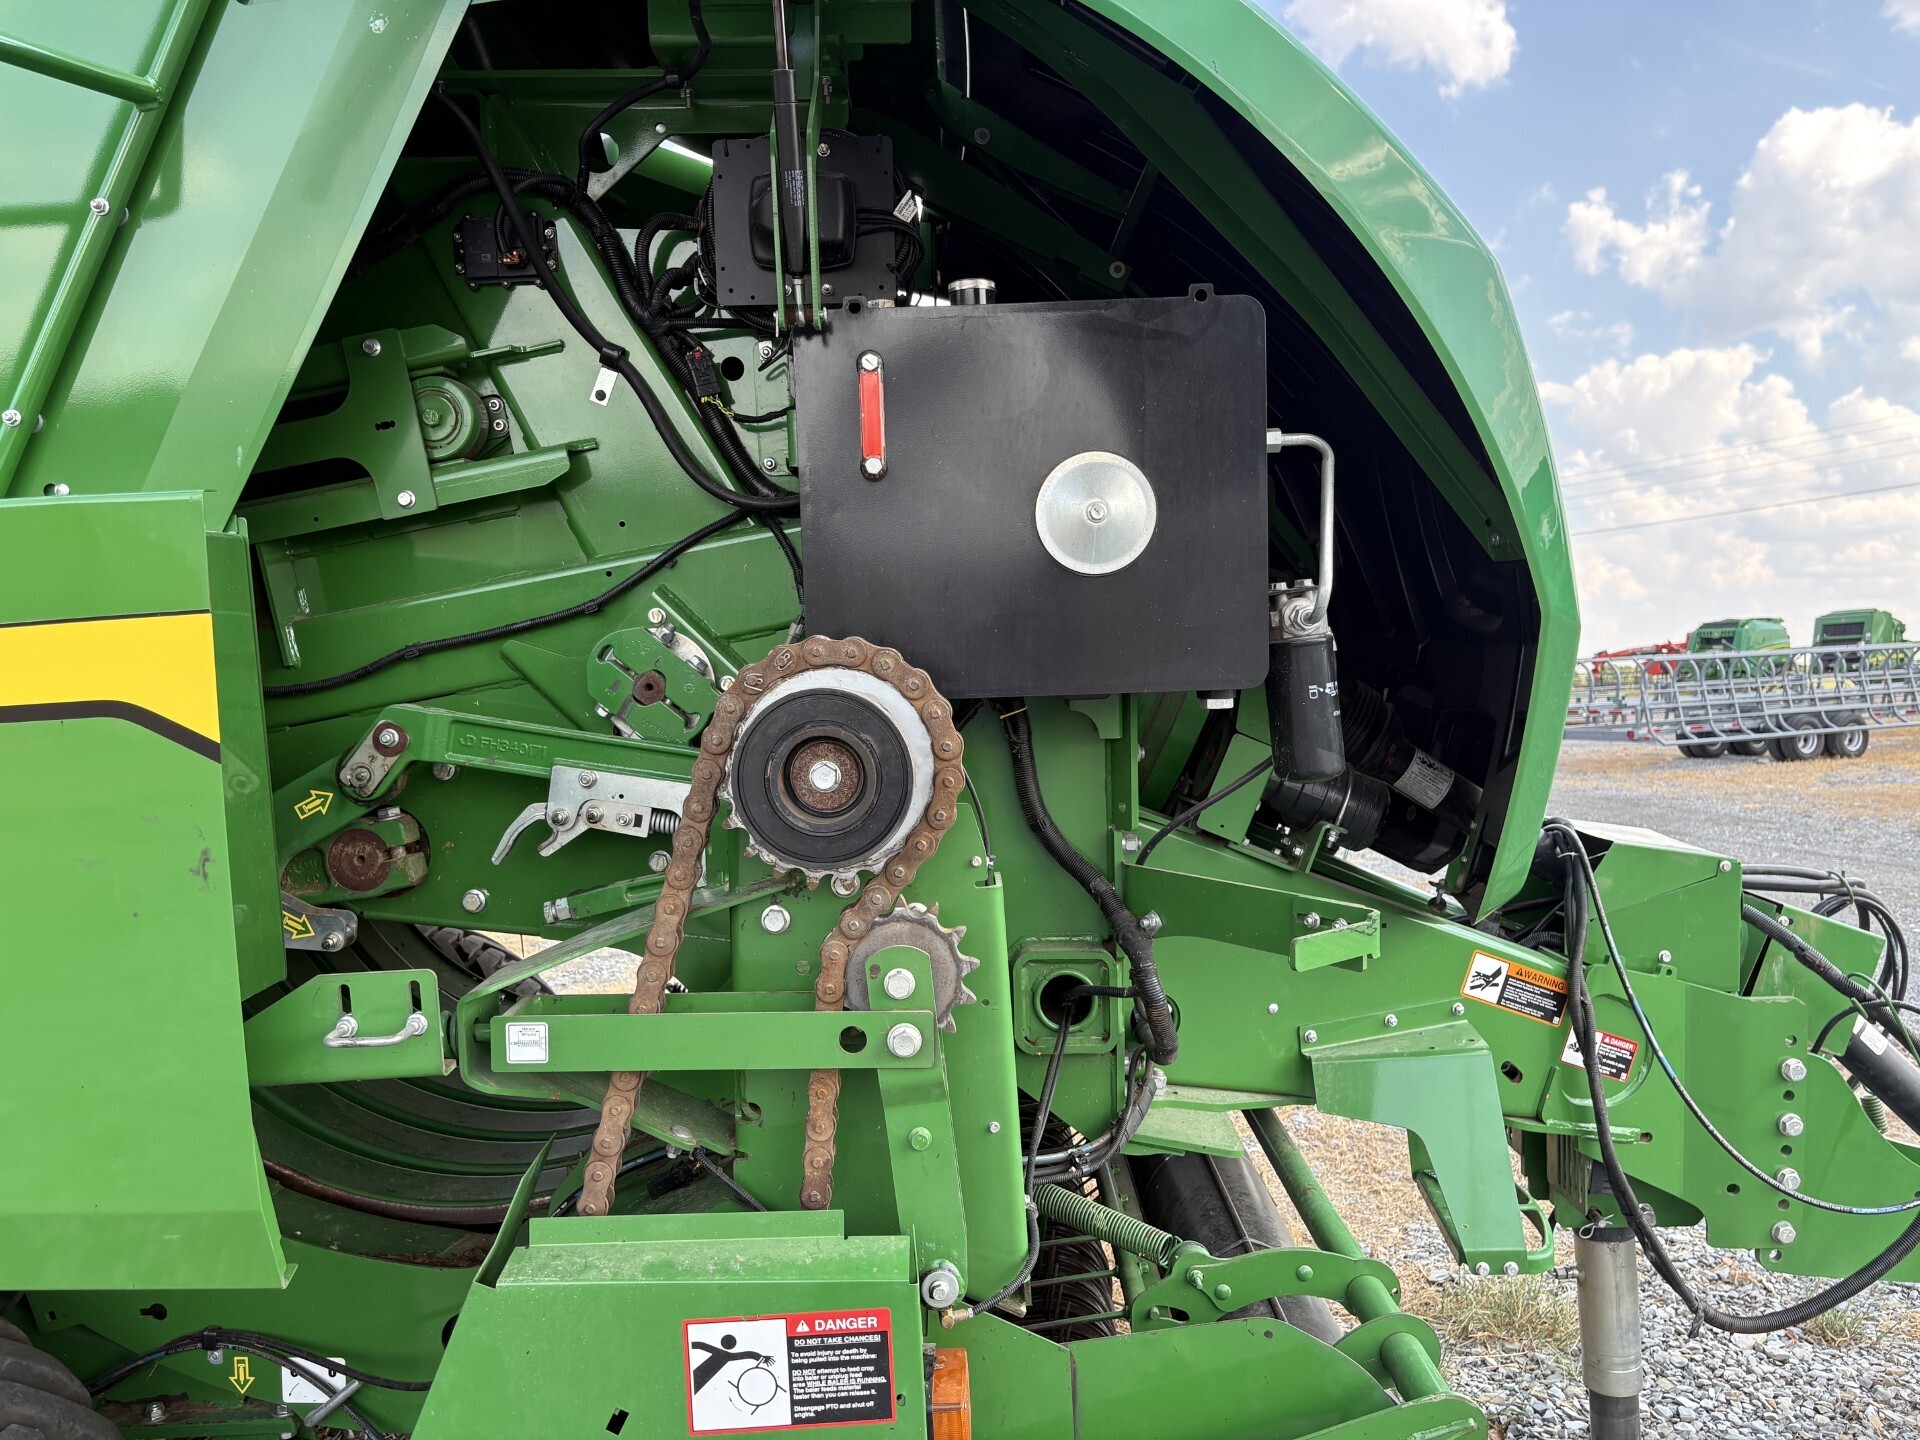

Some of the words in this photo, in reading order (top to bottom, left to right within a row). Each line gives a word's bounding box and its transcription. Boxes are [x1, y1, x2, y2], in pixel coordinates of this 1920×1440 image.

[1523, 972, 1564, 990] WARNING
[1610, 1039, 1634, 1050] DANGER
[815, 1317, 877, 1331] DANGER
[828, 1373, 848, 1381] unplug
[794, 1404, 825, 1413] Disengage
